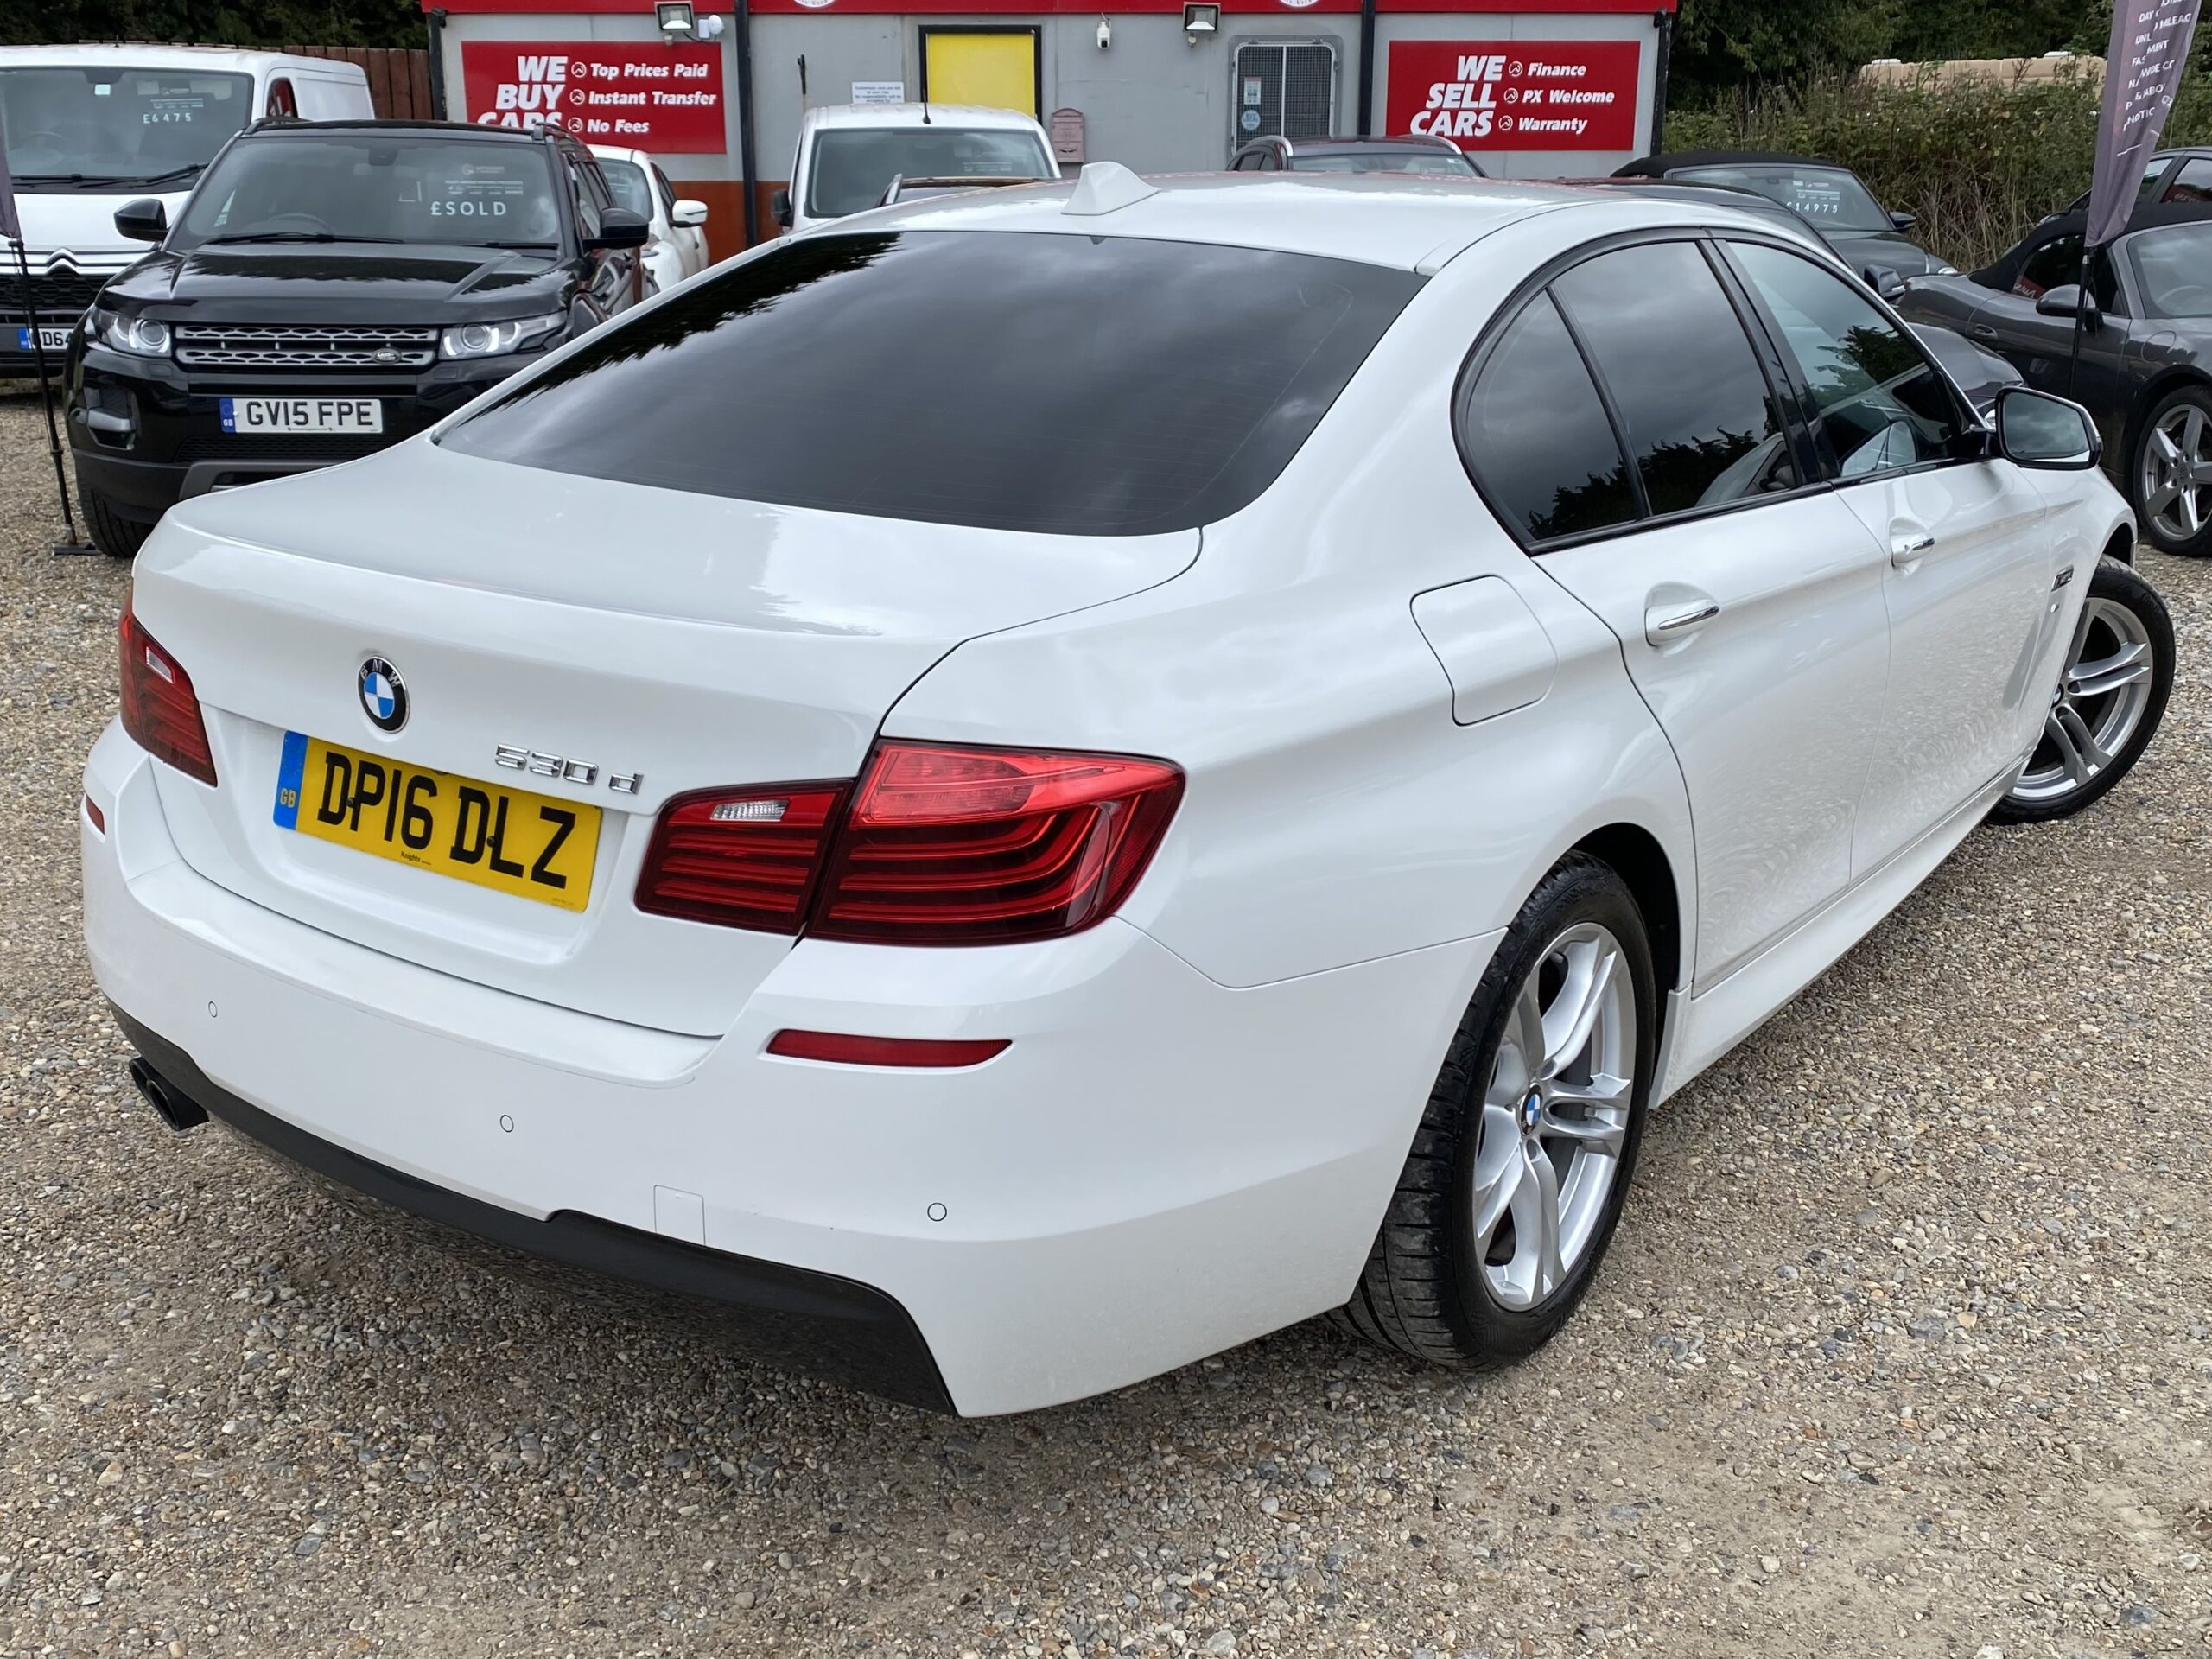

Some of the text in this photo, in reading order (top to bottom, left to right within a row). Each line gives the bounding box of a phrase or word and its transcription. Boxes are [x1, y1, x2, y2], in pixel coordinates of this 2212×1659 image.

[518, 56, 569, 82] WE
[590, 62, 708, 79] Top Prices Paid
[1457, 55, 1506, 81] WE
[1528, 62, 1586, 77] Finance
[496, 84, 565, 110] BUY
[588, 91, 716, 105] Instant Transfer
[1425, 83, 1497, 109] SELL
[1522, 89, 1614, 104] PX Welcome
[143, 113, 192, 124] £6475
[587, 119, 649, 133] No Fees
[1410, 111, 1492, 137] CARS
[1518, 117, 1587, 134] Warranty
[430, 201, 506, 216] £SOLD
[246, 401, 373, 426] GV15 FPE
[360, 659, 401, 688] BMW
[494, 743, 644, 796] 530 d
[280, 788, 296, 808] GB
[317, 751, 576, 890] DP16 DLZ
